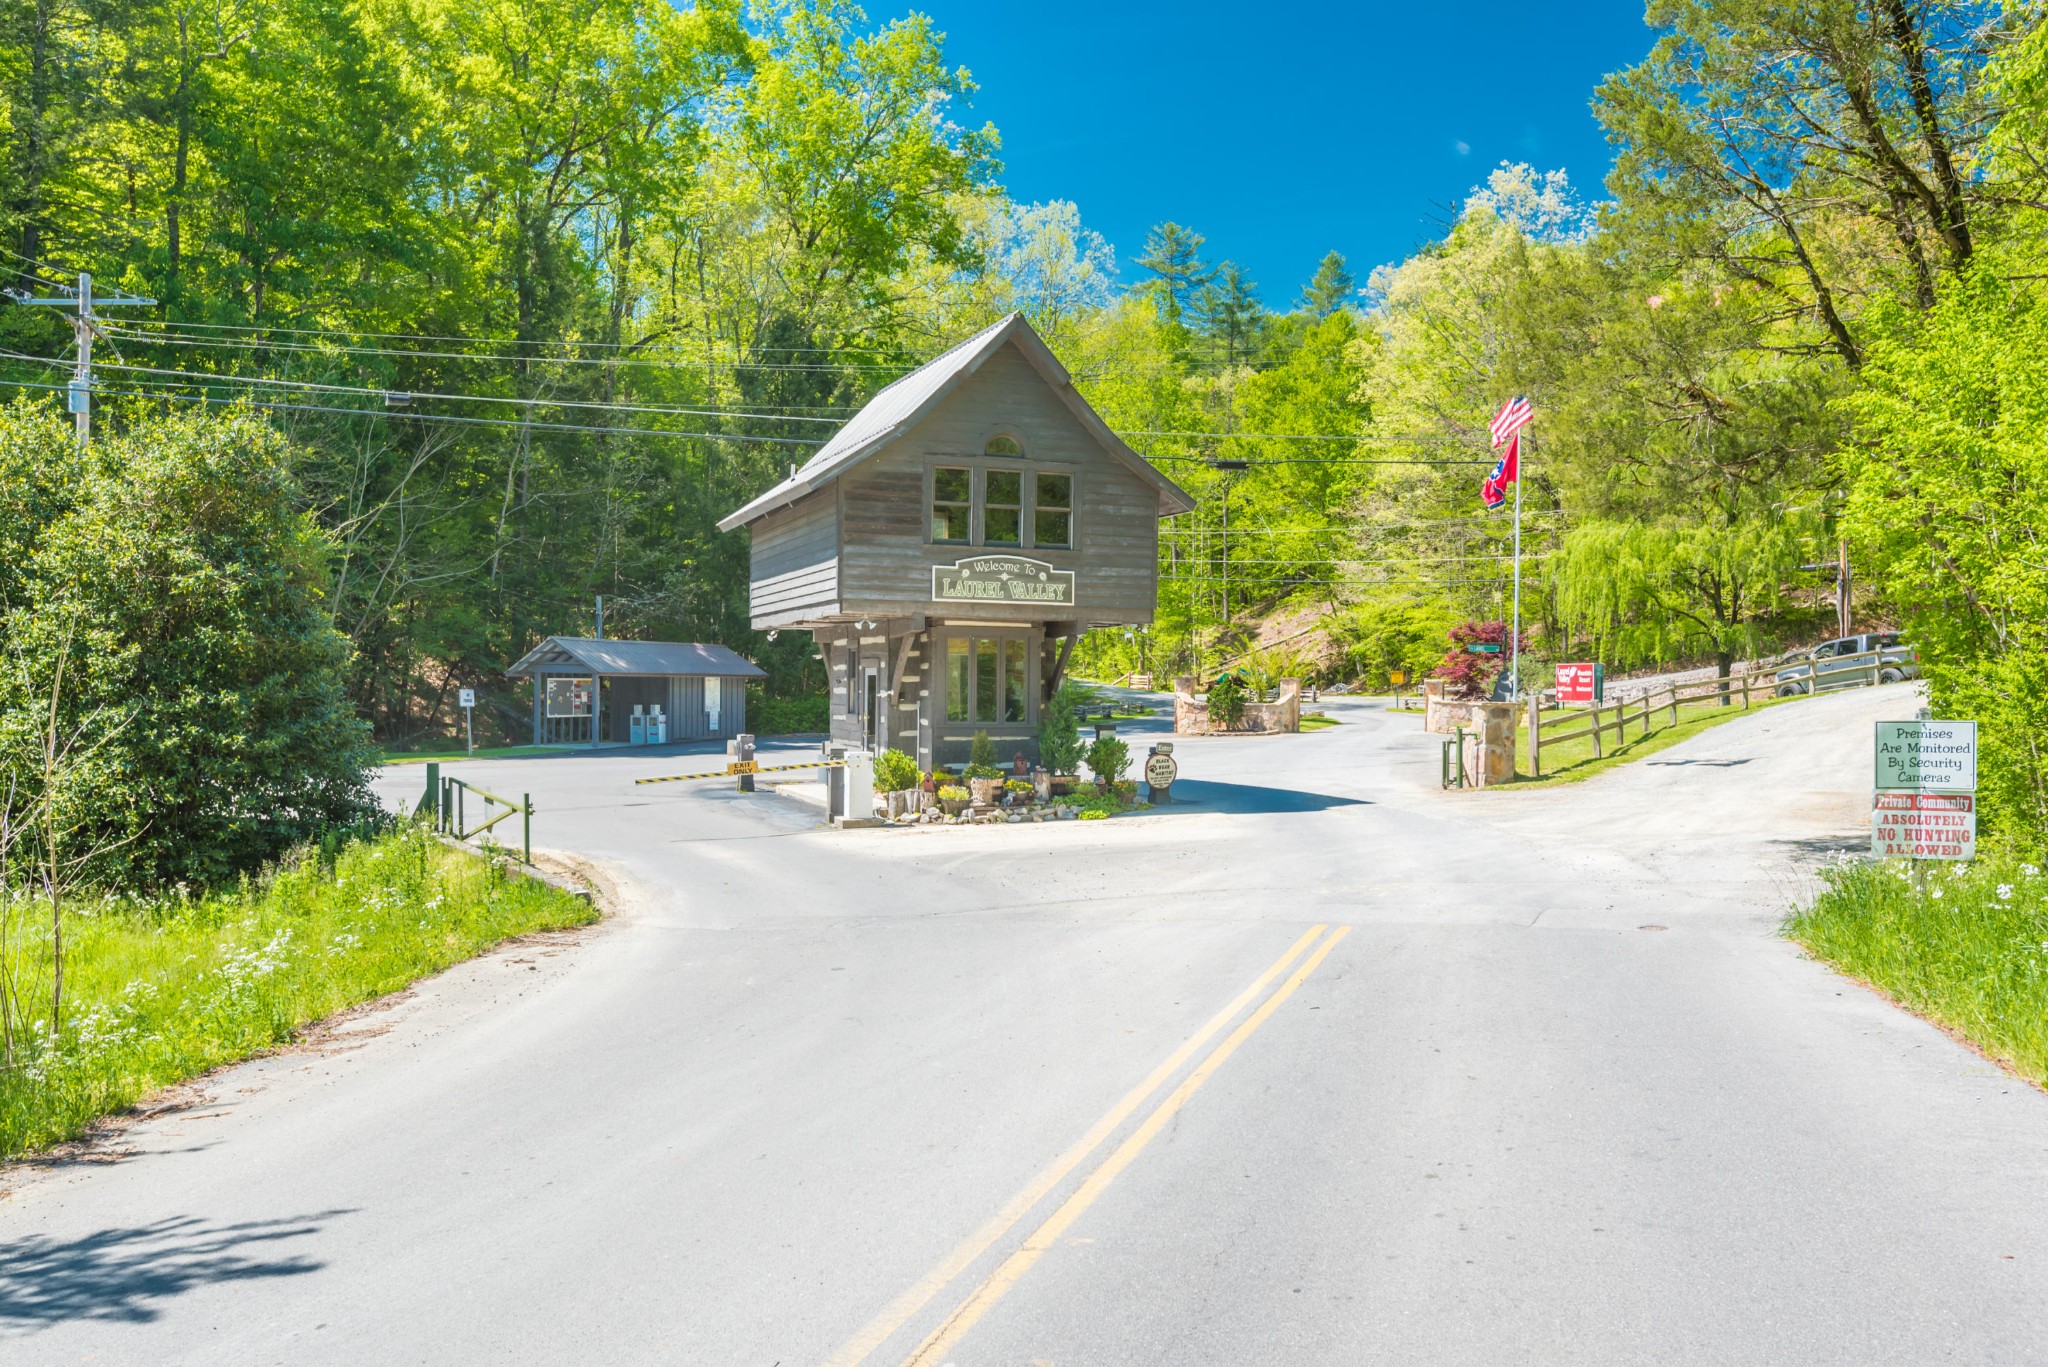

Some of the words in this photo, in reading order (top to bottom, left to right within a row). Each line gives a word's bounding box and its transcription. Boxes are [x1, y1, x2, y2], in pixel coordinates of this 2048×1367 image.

[973, 561, 1020, 573] Welcome
[1024, 564, 1036, 575] To
[942, 578, 1004, 598] LAUREL
[1008, 580, 1067, 600] VALLEY
[1896, 728, 1953, 739] Premises
[1158, 744, 1172, 752] Enter
[1880, 743, 1902, 754] Are
[1907, 743, 1971, 754] Monitored
[1888, 757, 1905, 770] By
[1909, 757, 1962, 771] Security
[1897, 771, 1951, 783] Cameras
[1877, 795, 1912, 808] Private
[1916, 796, 1970, 811] Community
[1882, 814, 1966, 826] ABSOLUTELY
[1877, 828, 1896, 841] NO
[1904, 829, 1971, 842] HUNTING
[1885, 844, 1962, 856] ALLOWED
